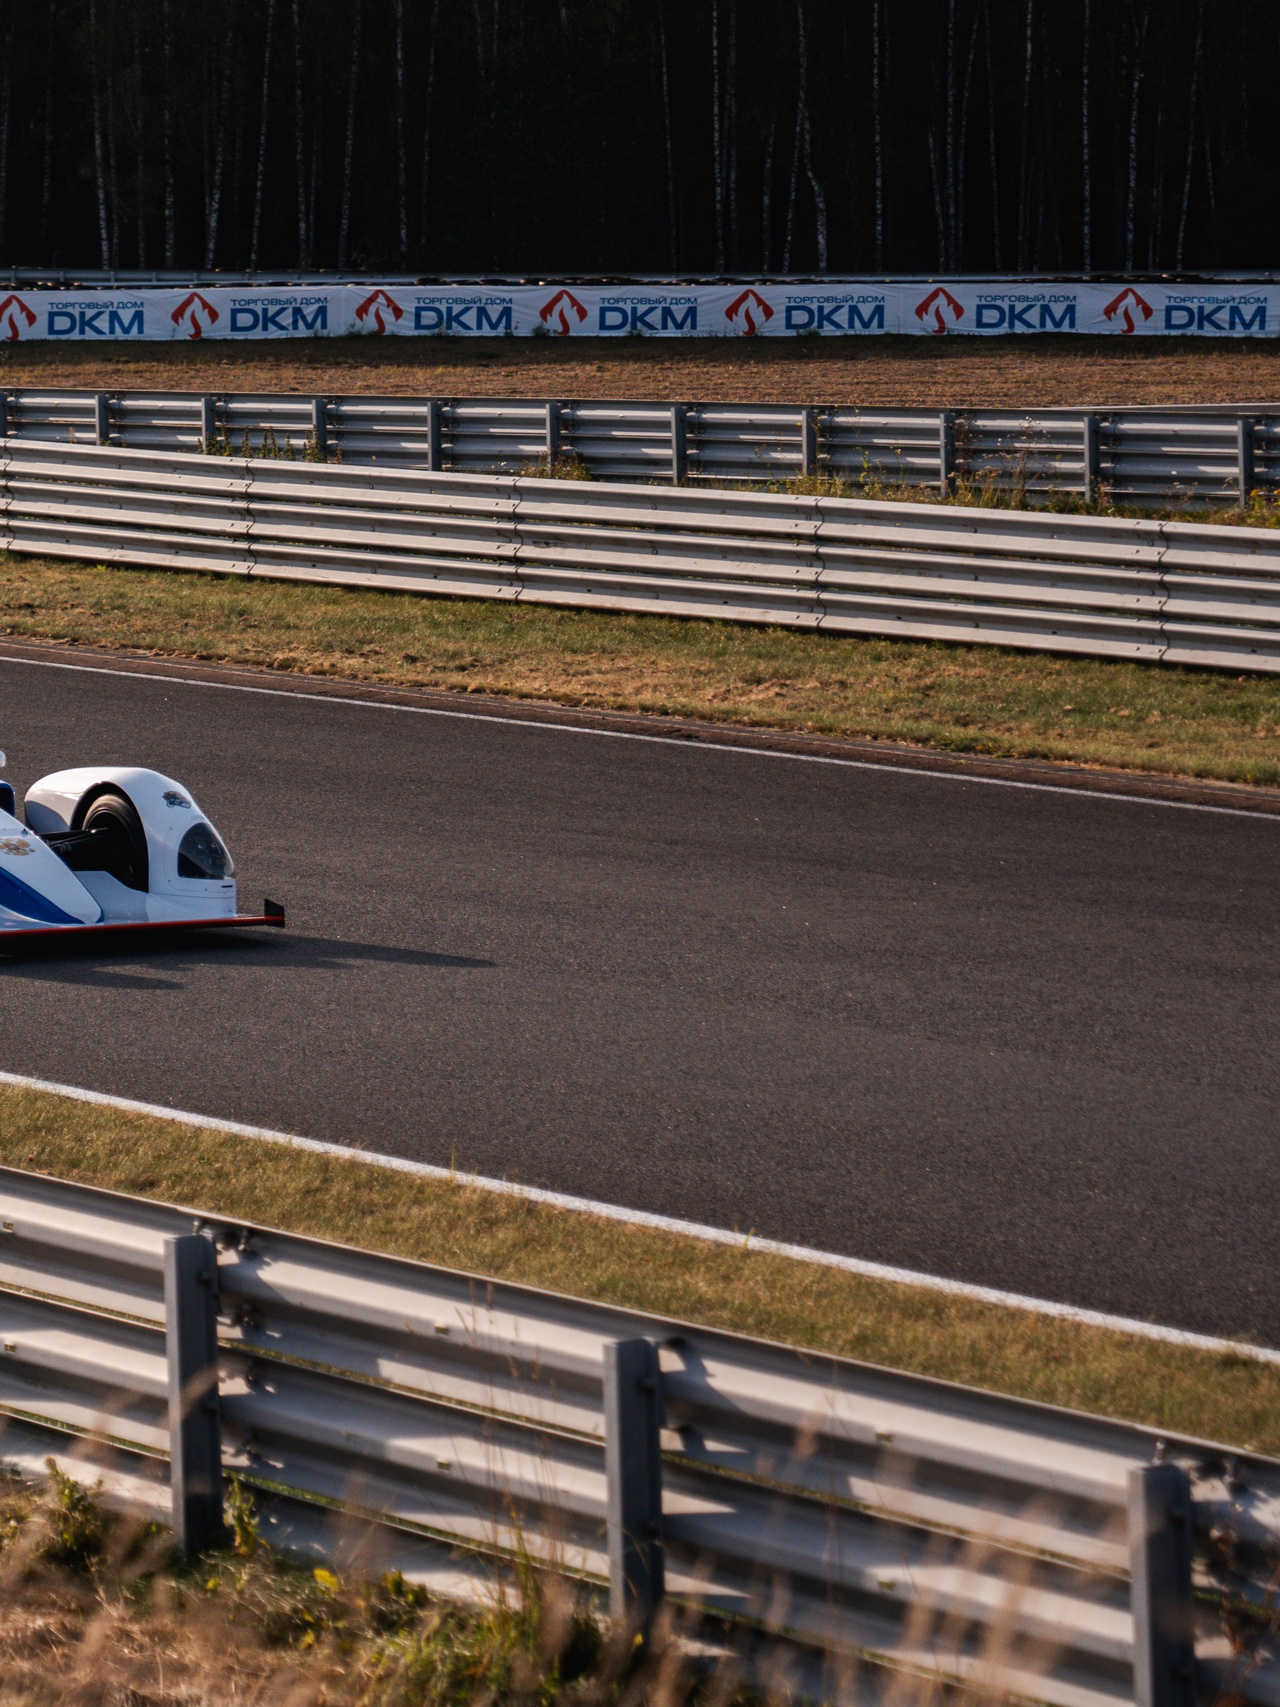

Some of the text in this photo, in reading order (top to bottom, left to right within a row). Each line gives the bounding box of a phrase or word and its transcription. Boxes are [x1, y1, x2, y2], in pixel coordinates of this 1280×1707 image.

[48, 301, 144, 311] ТОРГОВЫЙ ДОМ
[230, 298, 328, 308] ТОРГОВЫЙ ДОМ
[415, 296, 512, 306] ТОРГОВЫЙ ДОМ
[600, 297, 698, 306] ТОРГОВЫЙ ДОМ
[786, 295, 885, 305] ТОРГОВЫЙ ДОМ
[976, 294, 1076, 304] ТОРГОВЫЙ ДОМ
[1166, 296, 1268, 305] ТОРГОВЫЙ ДОМ
[48, 310, 144, 335] DKM
[230, 306, 328, 332] DKM
[414, 306, 512, 331] DKM
[599, 306, 698, 331] DKM
[785, 304, 884, 330] DKM
[976, 304, 1076, 329] DKM
[1164, 305, 1267, 330] DKM
